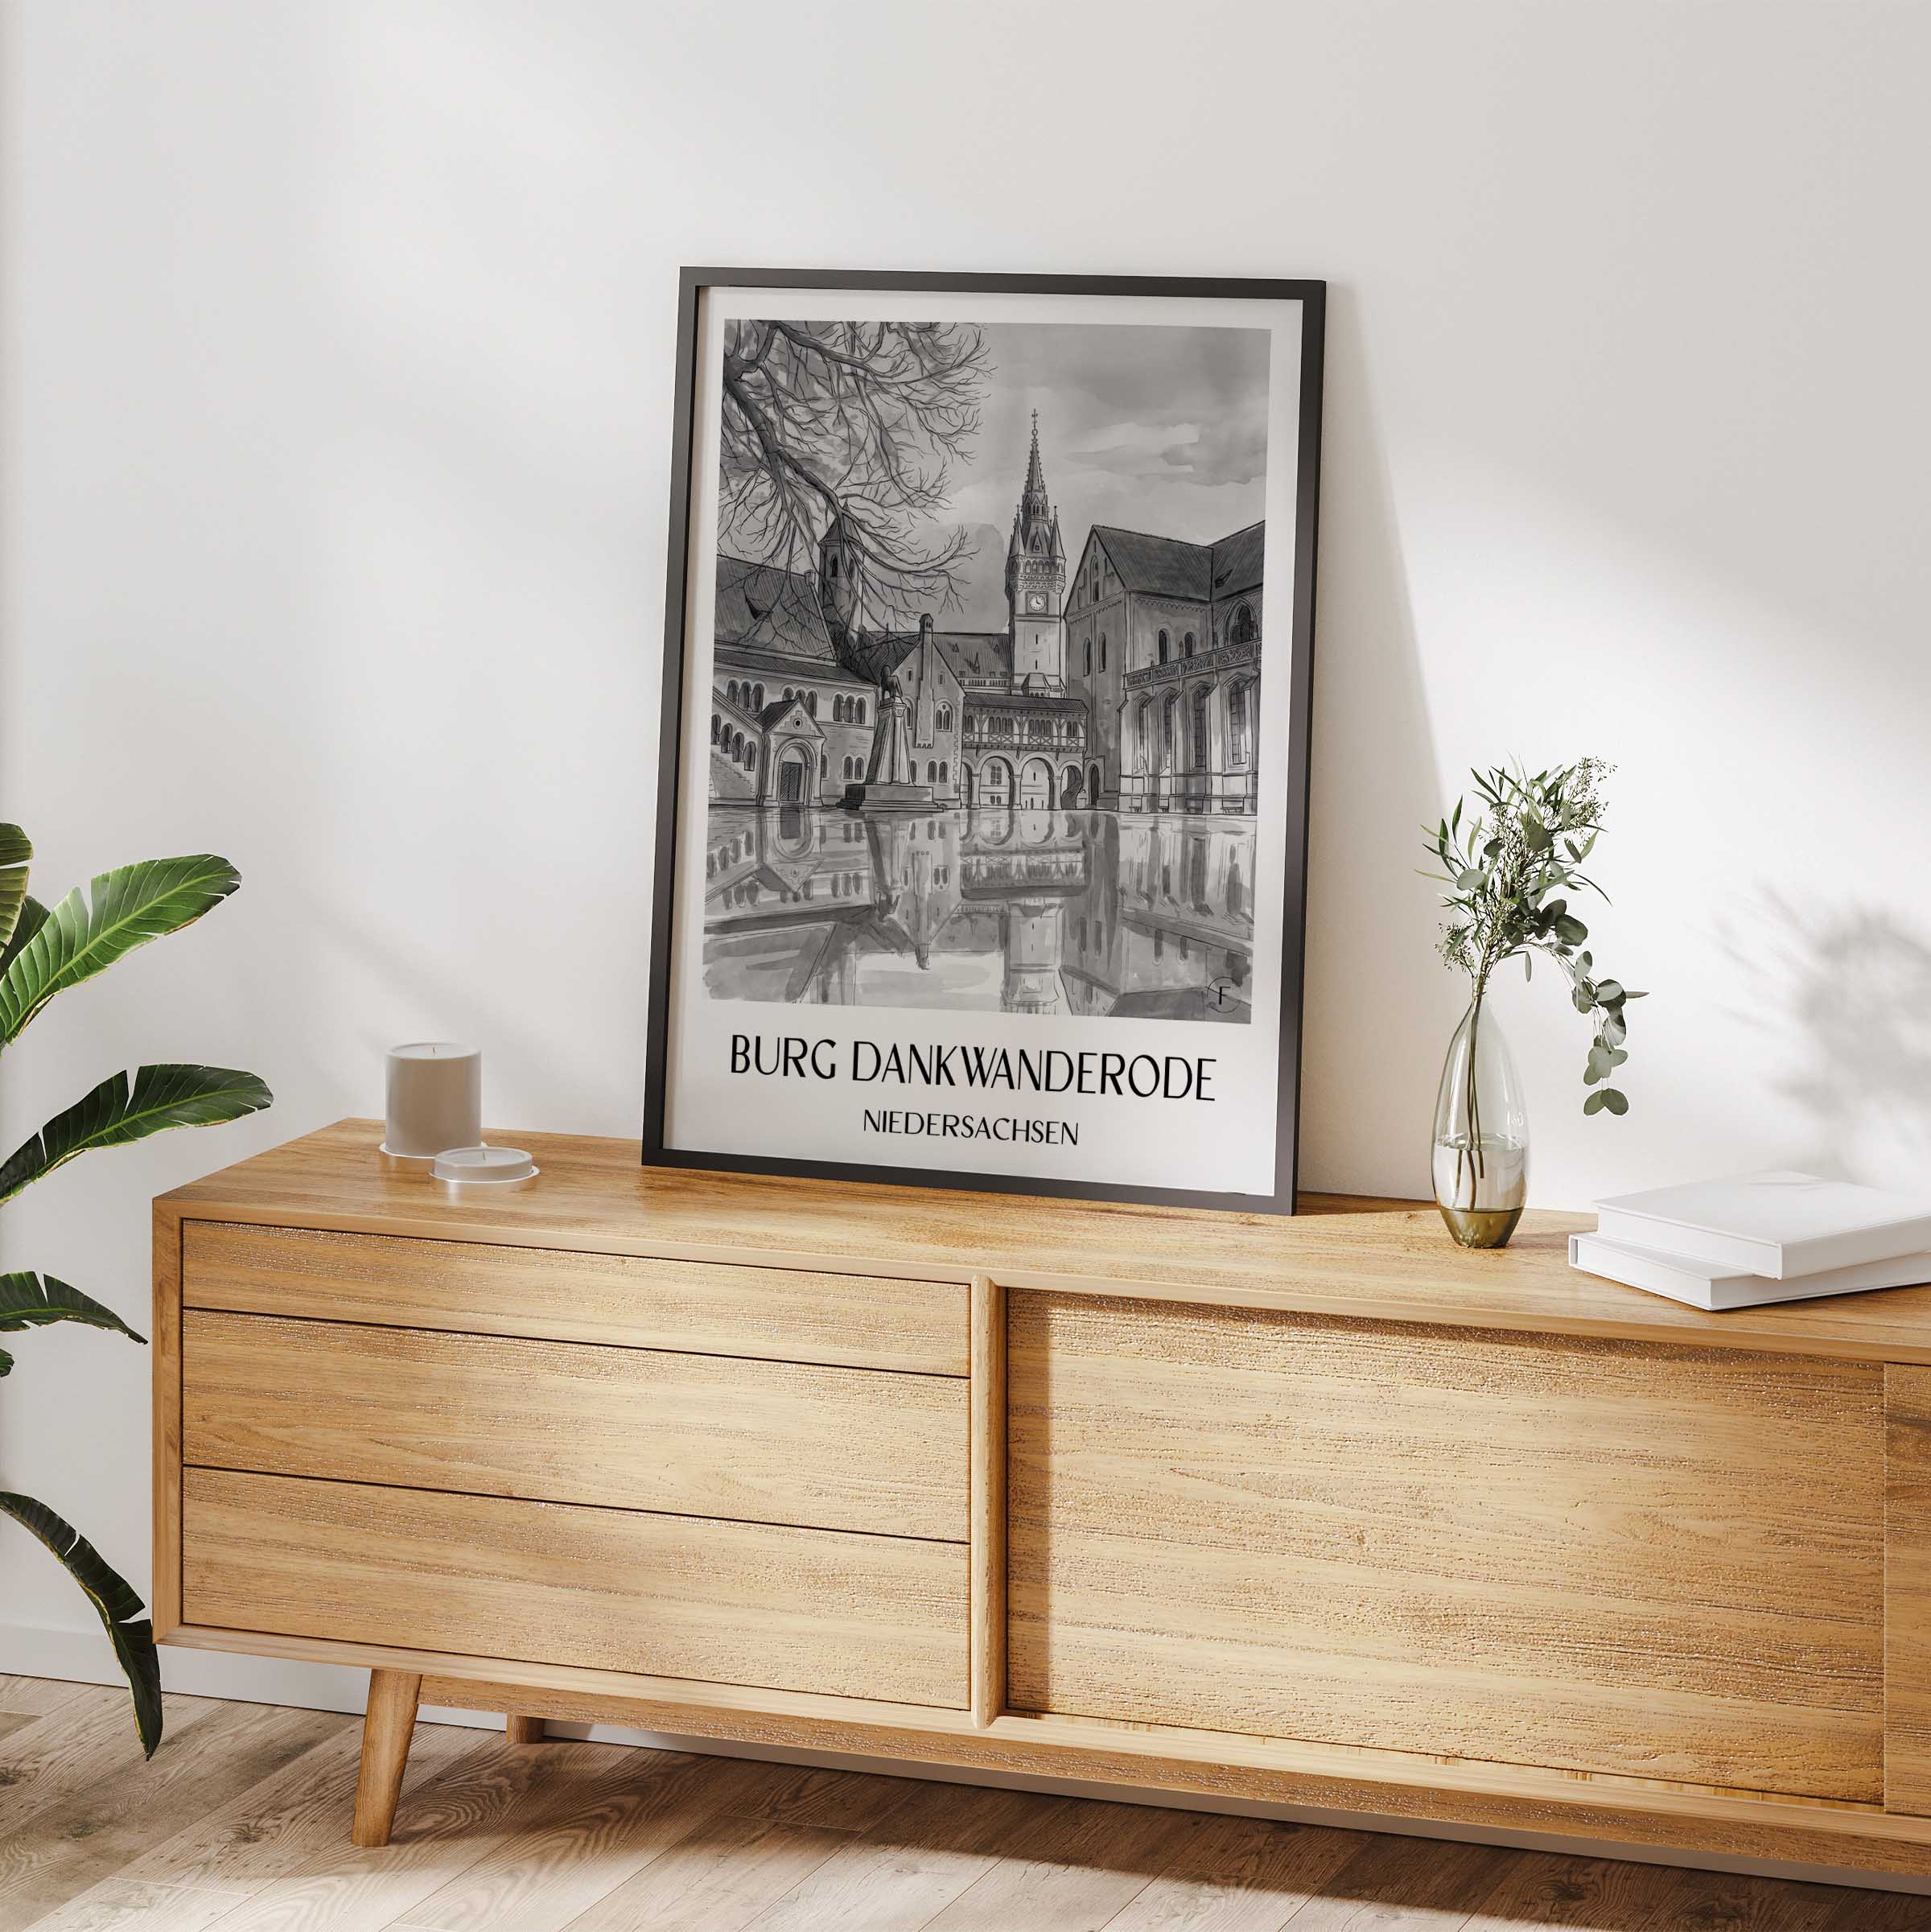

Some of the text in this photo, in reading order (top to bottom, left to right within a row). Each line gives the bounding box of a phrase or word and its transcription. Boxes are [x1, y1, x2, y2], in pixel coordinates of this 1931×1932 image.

[1219, 986, 1231, 1005] F
[731, 1035, 1217, 1102] BURG DANKWANDERODE
[863, 1109, 1079, 1146] NIEDERSACHSEN
